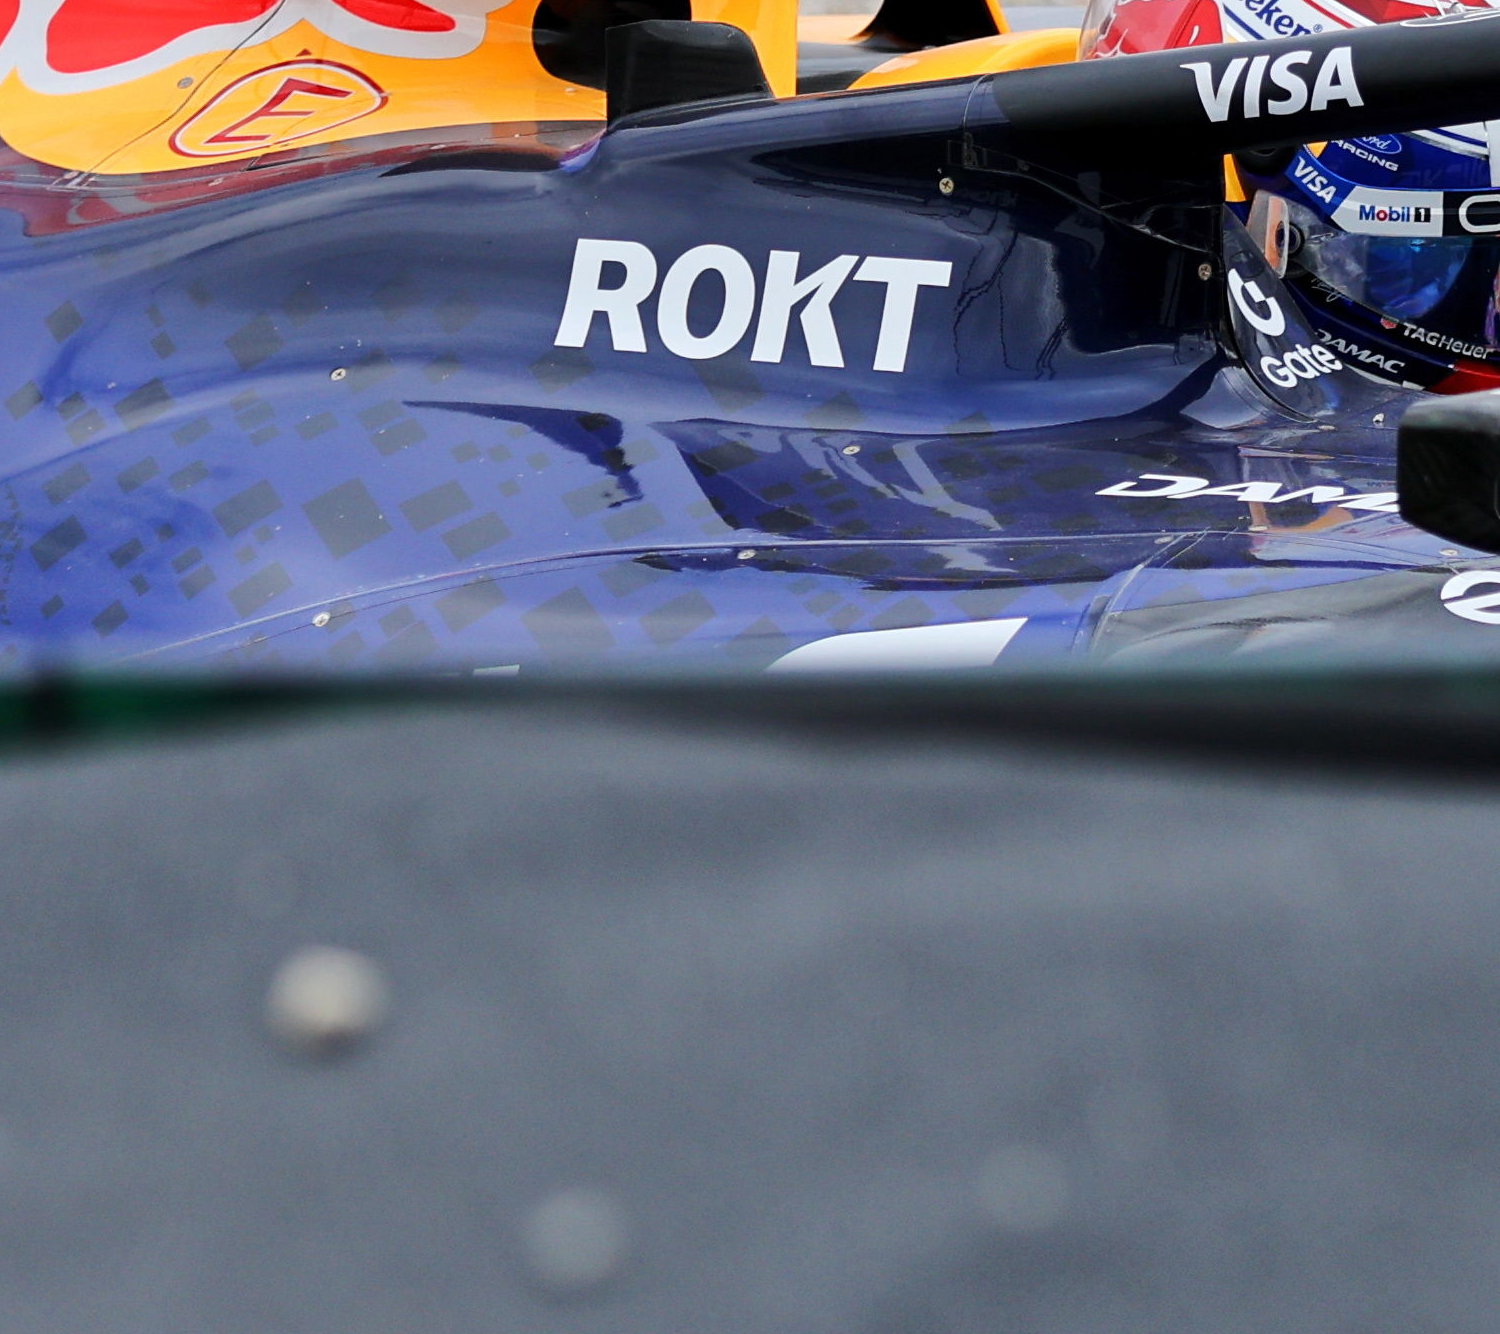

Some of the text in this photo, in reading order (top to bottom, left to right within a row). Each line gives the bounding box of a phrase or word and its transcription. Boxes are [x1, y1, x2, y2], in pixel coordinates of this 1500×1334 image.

[1180, 45, 1364, 122] VISA
[1296, 155, 1338, 204] VISA
[1359, 205, 1410, 222] Mobil
[553, 238, 953, 373] ROKT
[1260, 344, 1344, 388] Gate
[1094, 473, 1399, 513] DAM
